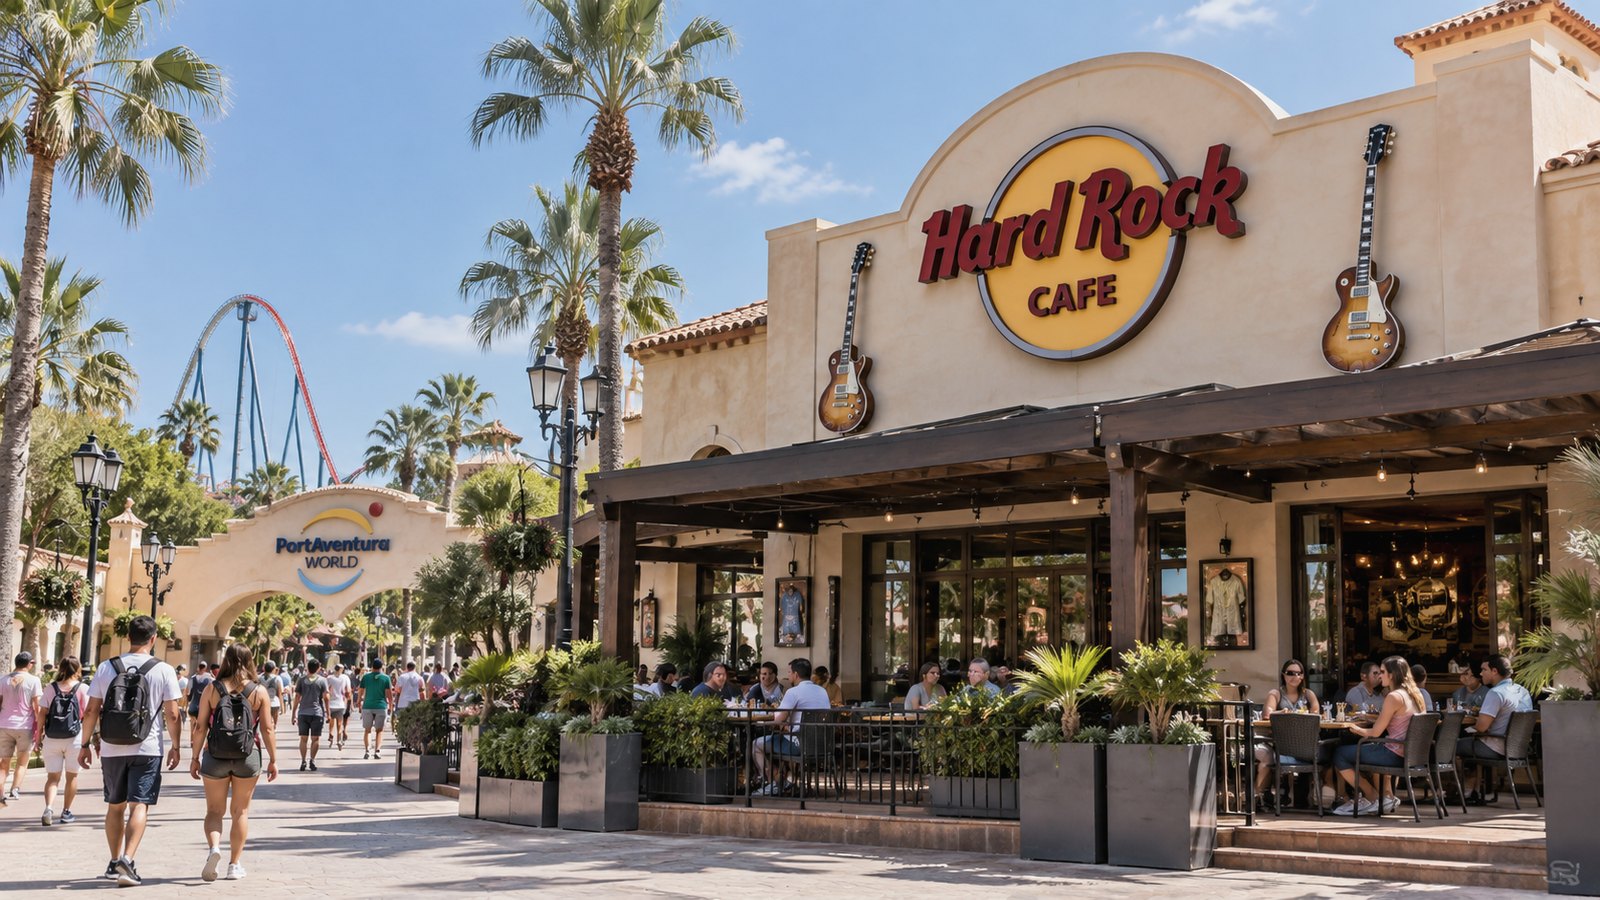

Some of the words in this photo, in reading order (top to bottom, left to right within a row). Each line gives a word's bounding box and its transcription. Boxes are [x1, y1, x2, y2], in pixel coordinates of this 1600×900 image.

[918, 180, 1075, 284] Hard
[1075, 143, 1248, 261] Rock
[1028, 274, 1117, 317] CAFE
[276, 536, 390, 553] PortAventura
[305, 556, 358, 569] WORLD
